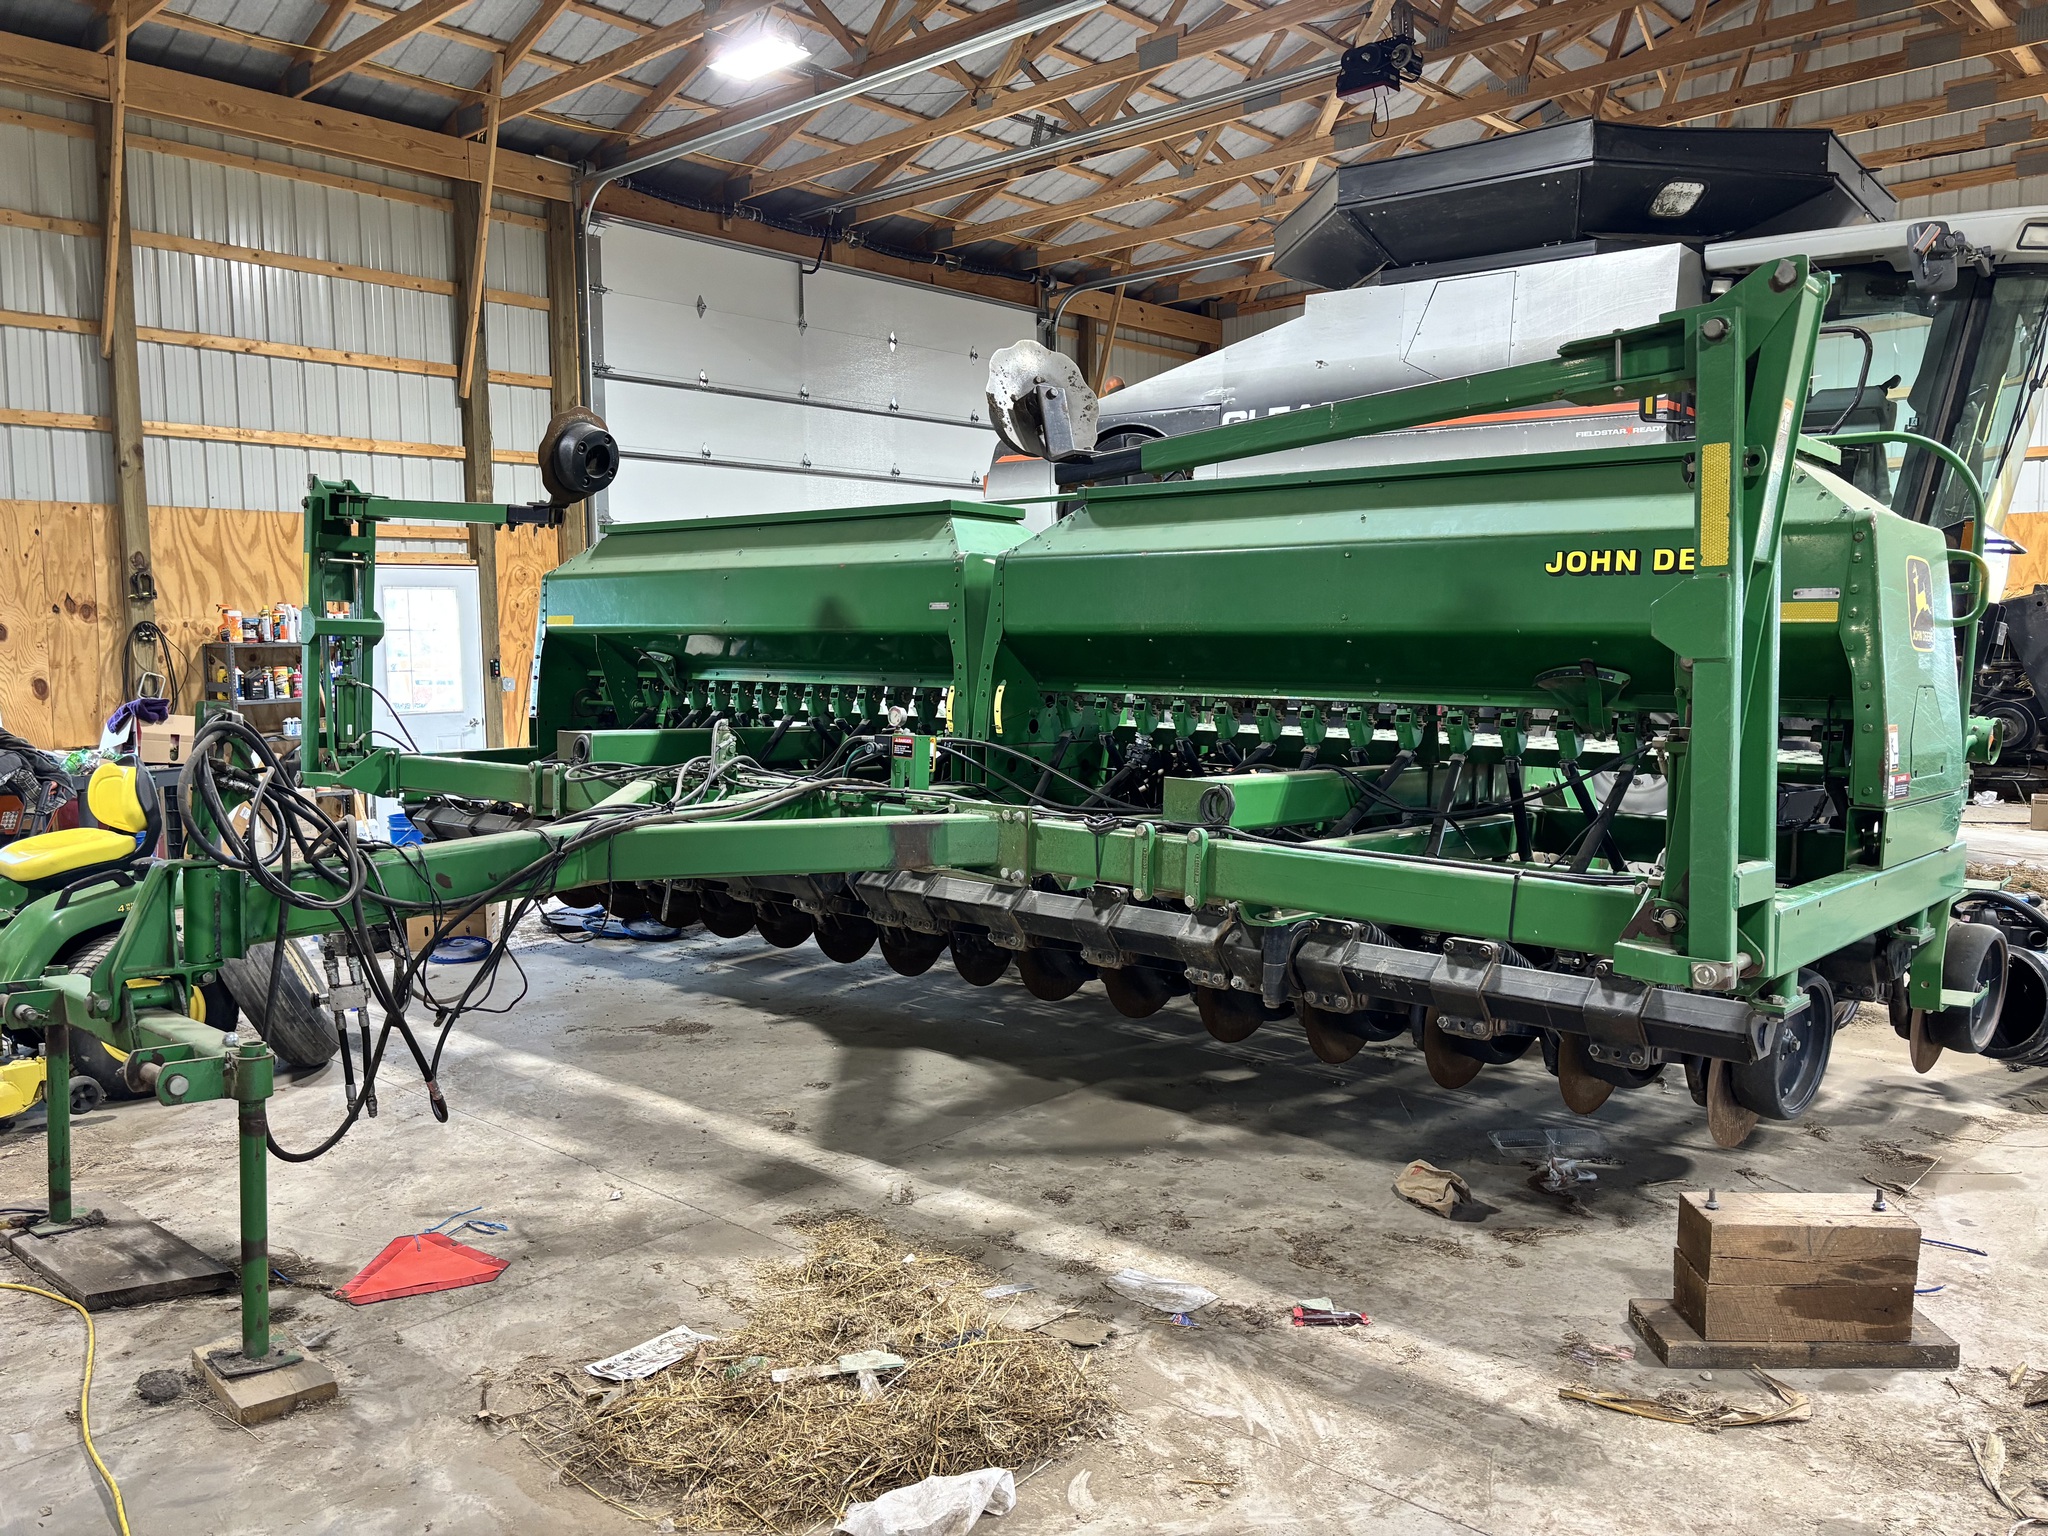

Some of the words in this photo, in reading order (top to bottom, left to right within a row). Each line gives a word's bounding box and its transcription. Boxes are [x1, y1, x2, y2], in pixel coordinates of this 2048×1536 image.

[1575, 430, 1627, 438] FIELDSTAR
[1632, 425, 1667, 435] READY
[1545, 549, 1640, 576] JOHN
[117, 904, 125, 912] 4
